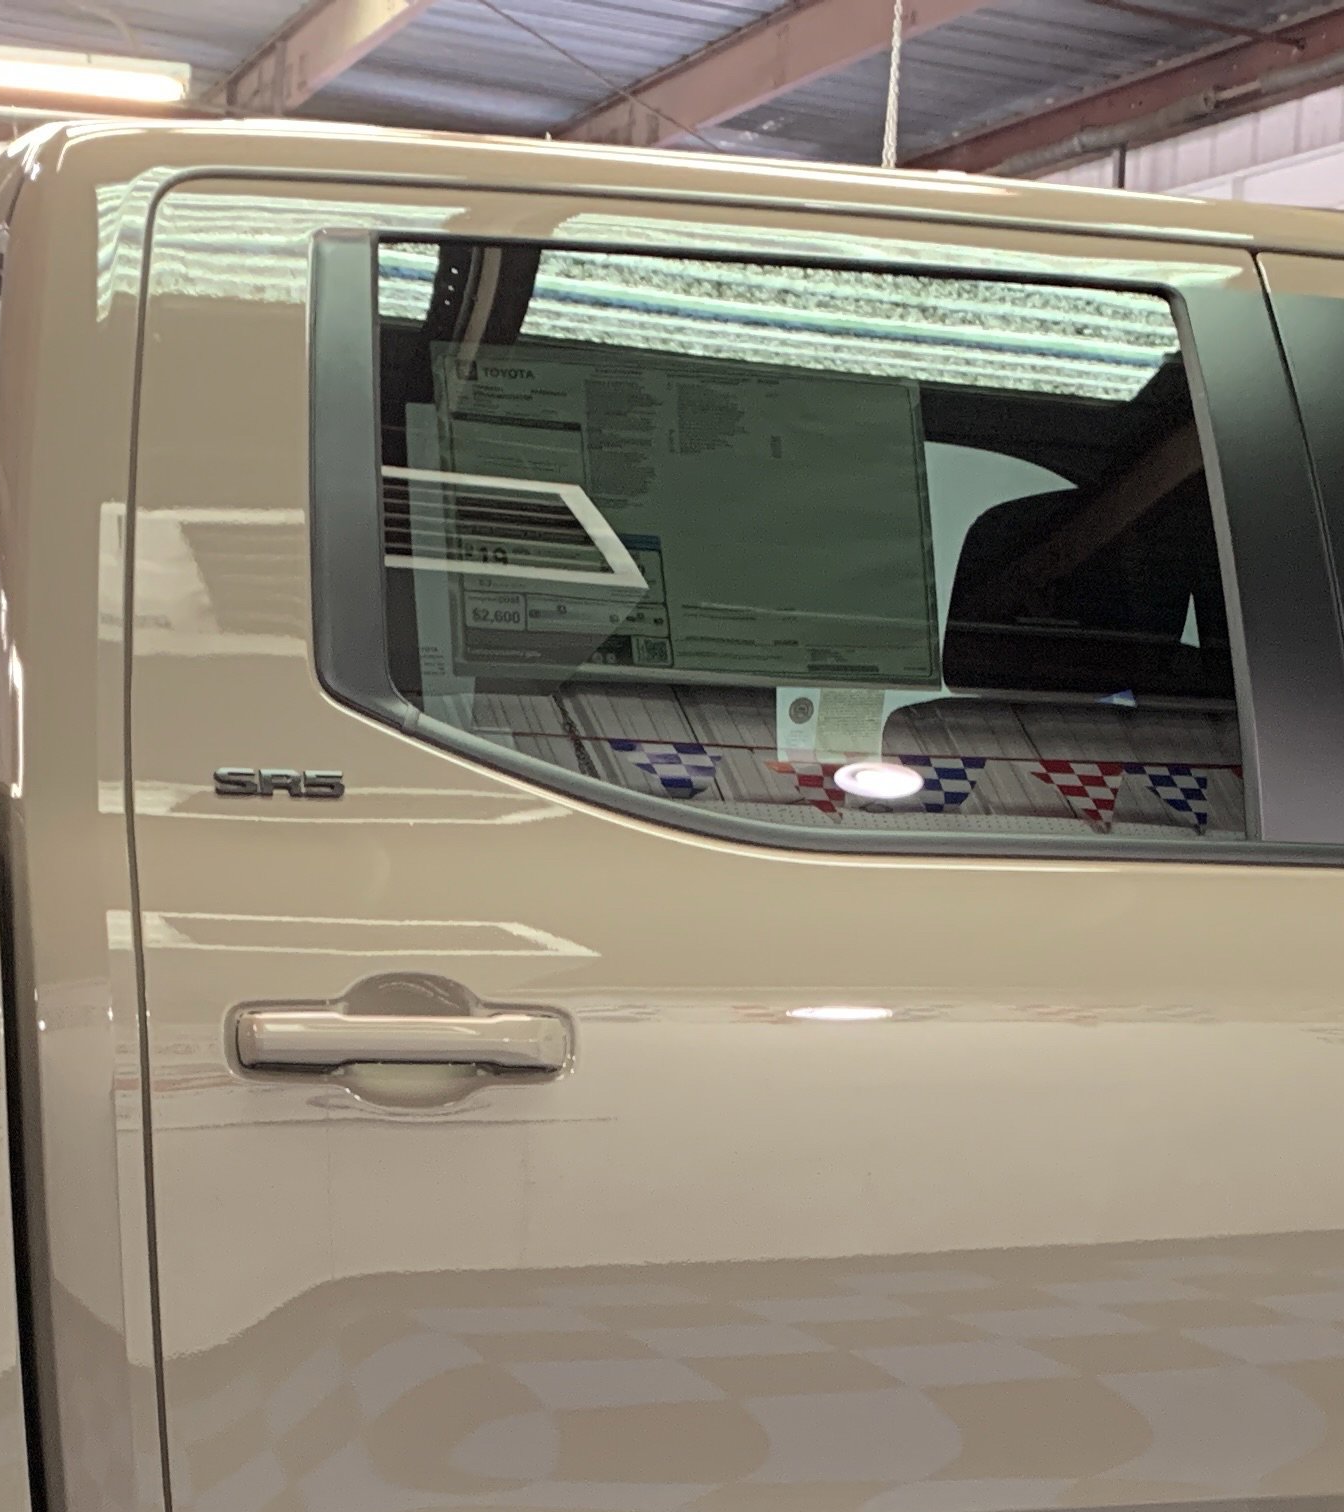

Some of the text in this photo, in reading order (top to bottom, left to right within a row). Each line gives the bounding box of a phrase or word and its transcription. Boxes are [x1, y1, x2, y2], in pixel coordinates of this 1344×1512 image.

[483, 367, 535, 380] TOYOTA
[472, 608, 520, 624] $2,600
[213, 767, 345, 798] SR5
